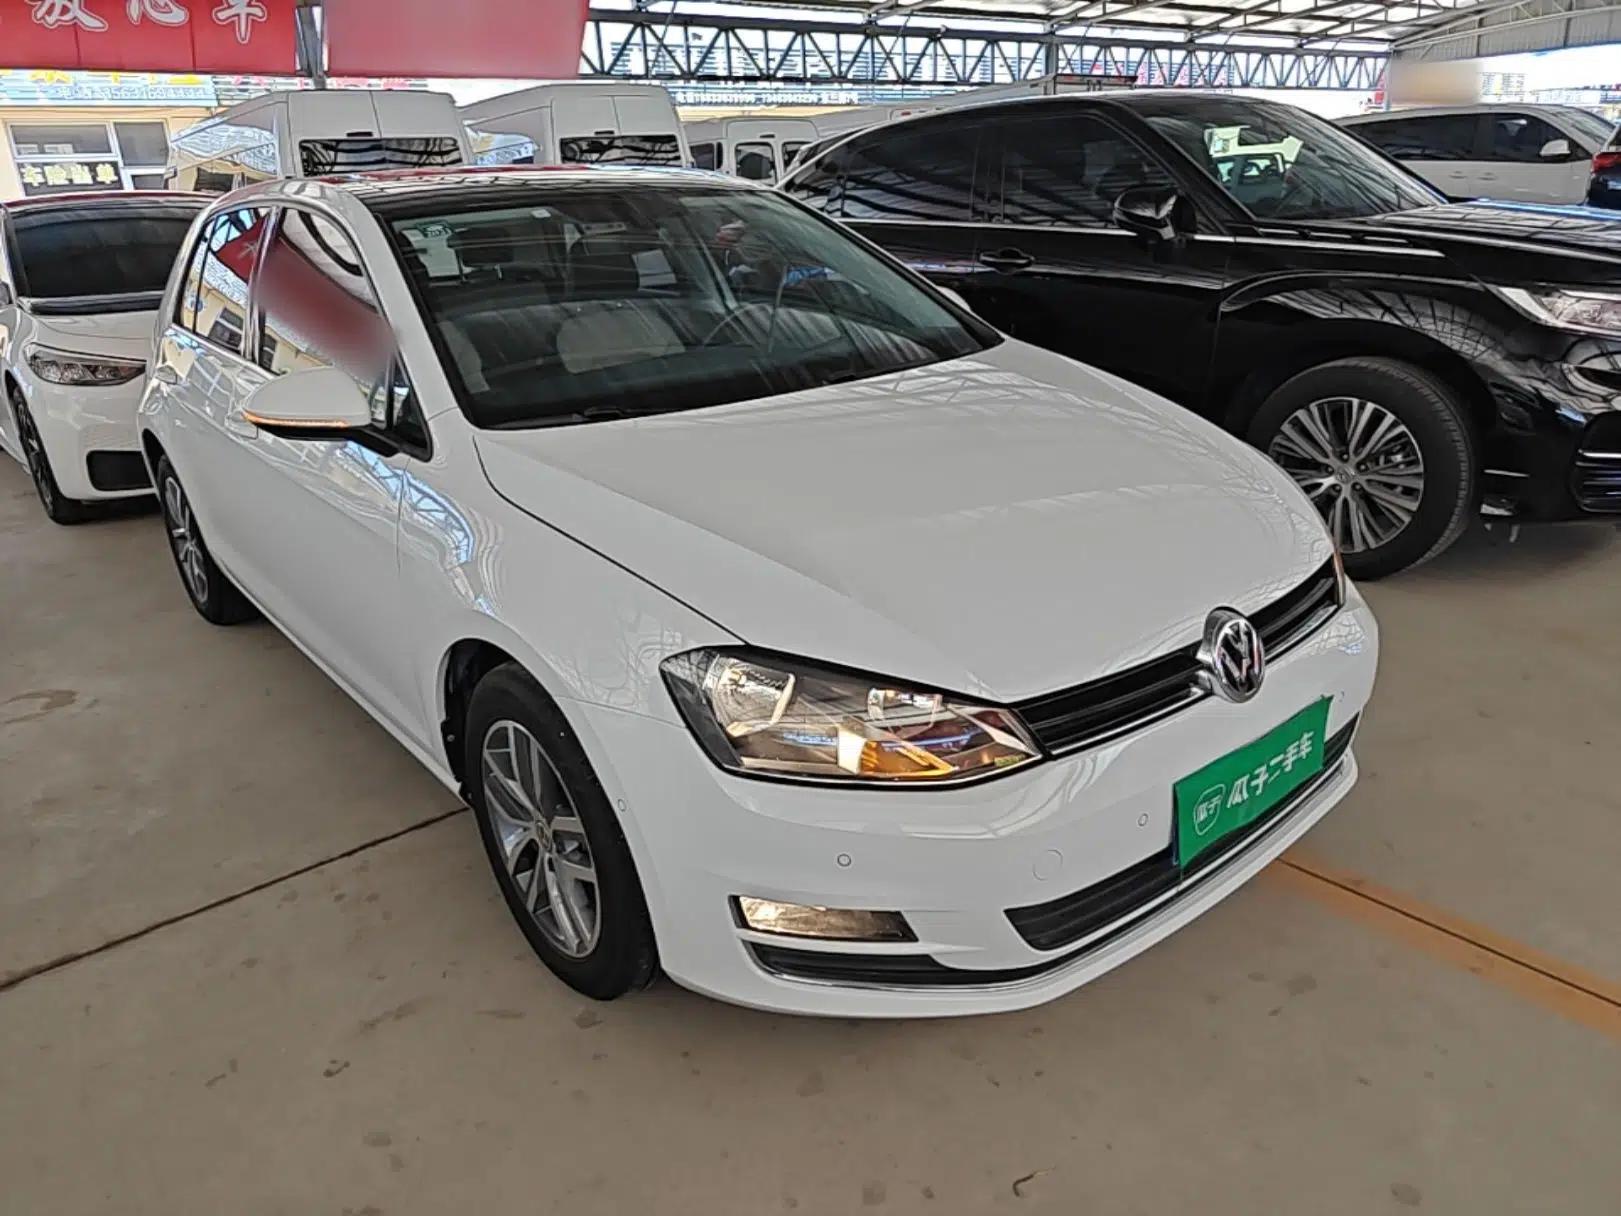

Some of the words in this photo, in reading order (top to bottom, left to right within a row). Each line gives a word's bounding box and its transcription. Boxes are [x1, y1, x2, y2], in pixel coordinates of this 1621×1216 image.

[1226, 731, 1314, 809] 瓜子二手车
